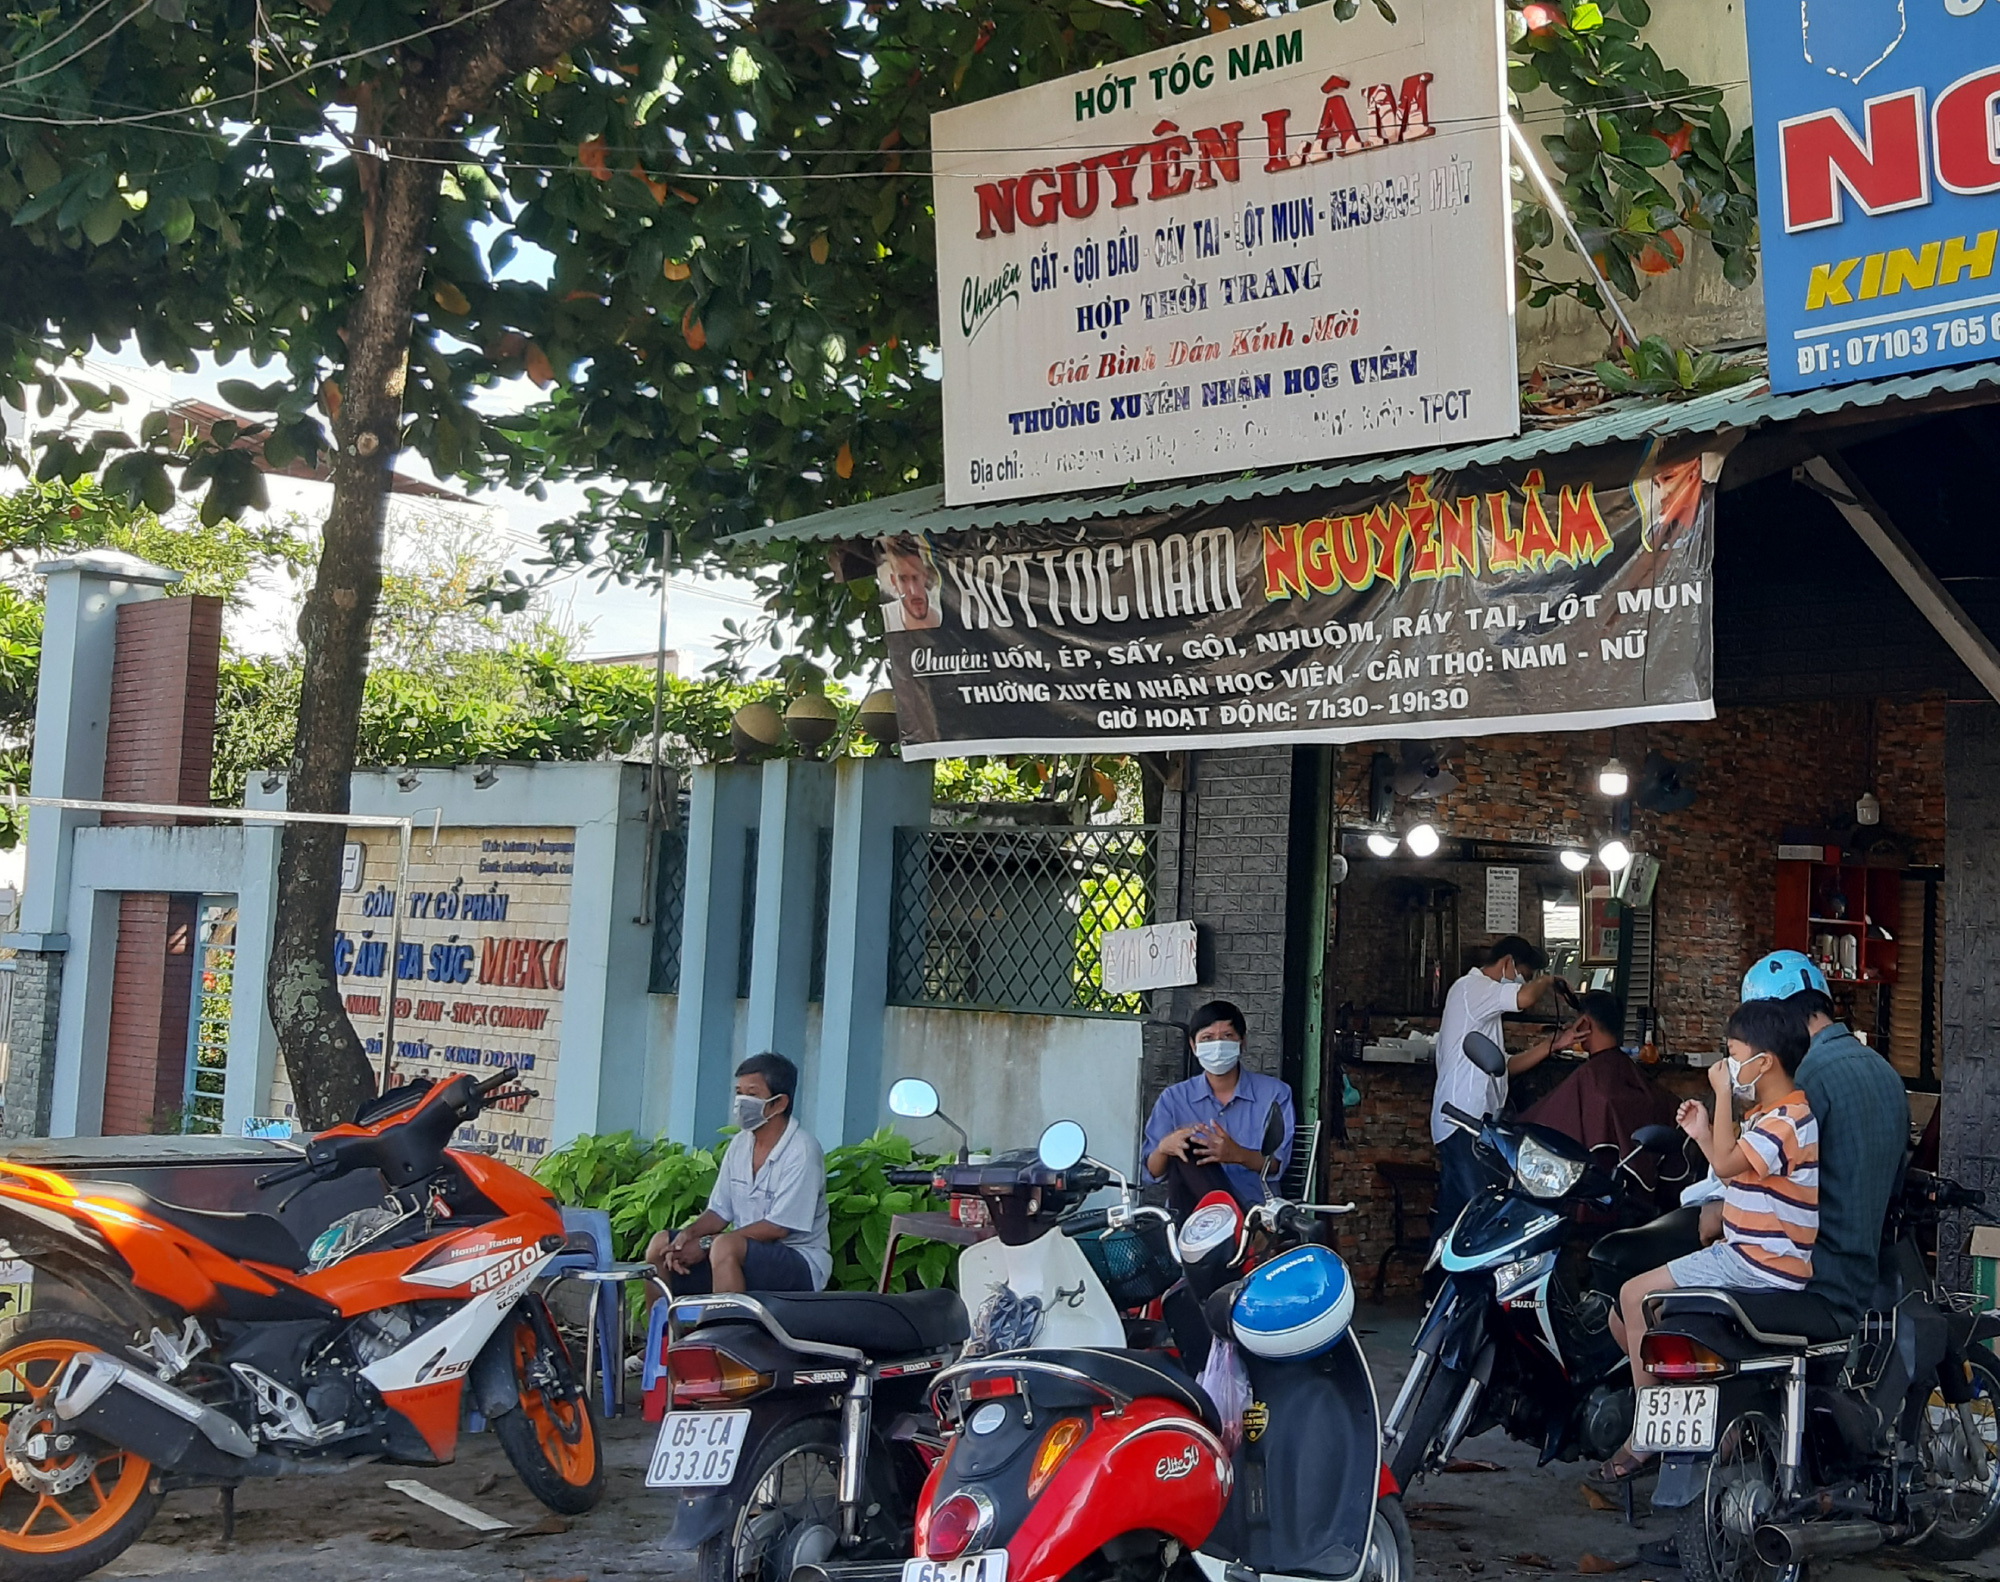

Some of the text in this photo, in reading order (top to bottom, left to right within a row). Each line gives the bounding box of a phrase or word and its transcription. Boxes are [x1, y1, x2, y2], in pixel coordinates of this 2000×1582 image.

[1075, 30, 1304, 121] HỚT TÓC NAM
[1262, 72, 1436, 173] LÂM
[961, 263, 1022, 346] Chuyên
[1030, 241, 1058, 293] CẮT
[1107, 226, 1139, 277] ĐẦU
[1193, 216, 1220, 259] TAI
[1272, 196, 1314, 248] MỤN
[1330, 171, 1421, 232] MASSAGE
[1805, 229, 1999, 310] KINH
[1075, 258, 1323, 340] HỢP THỜI TRANG
[1047, 308, 1360, 387] Giá Bình Dân Kính Mời
[1797, 342, 1841, 374] ĐT:
[1846, 325, 1929, 366] 07103
[1932, 315, 1987, 351] 765
[1008, 345, 1418, 435] THƯỜNG XUYÊN NHẬN HỌC VIÊN
[970, 459, 993, 491] Địa
[1419, 389, 1472, 424] TPCT
[949, 536, 1038, 630] HỚT
[1037, 526, 1130, 626] TÓC
[1132, 526, 1242, 620] NAM
[1485, 468, 1614, 574] LÂM
[1060, 645, 1103, 670] ÉP,
[1108, 636, 1174, 666] SẤY,
[1256, 620, 1383, 654] NHUỘM,
[1393, 608, 1451, 640] RÁY
[1465, 604, 1527, 631] TAI,
[1538, 593, 1603, 626] LỘT
[1617, 581, 1703, 615] MỤN
[958, 680, 1051, 705] THƯỜNG
[1054, 678, 1133, 701] XUYÊN
[1138, 674, 1209, 701] NHẬN
[1215, 670, 1275, 696] HỌC
[1280, 661, 1344, 690] VIÊN
[1367, 650, 1420, 683] CẦN
[1502, 643, 1567, 671] NAM
[1601, 630, 1648, 662] NỮ
[1097, 705, 1137, 730] GIỜ
[1145, 706, 1211, 731] HOẠT
[1220, 699, 1298, 729] ĐỘNG:
[362, 885, 399, 917] CÔN
[410, 892, 432, 918] TY
[489, 1005, 549, 1030] COMPANY
[451, 1235, 523, 1258] Honda Racing
[470, 1240, 546, 1293] REPSOL
[1510, 1300, 1545, 1309] SUZUKI
[431, 1358, 473, 1379] 150
[813, 1371, 848, 1383] HONDA
[903, 1361, 932, 1373] HONDA
[654, 1449, 735, 1481] 033.05
